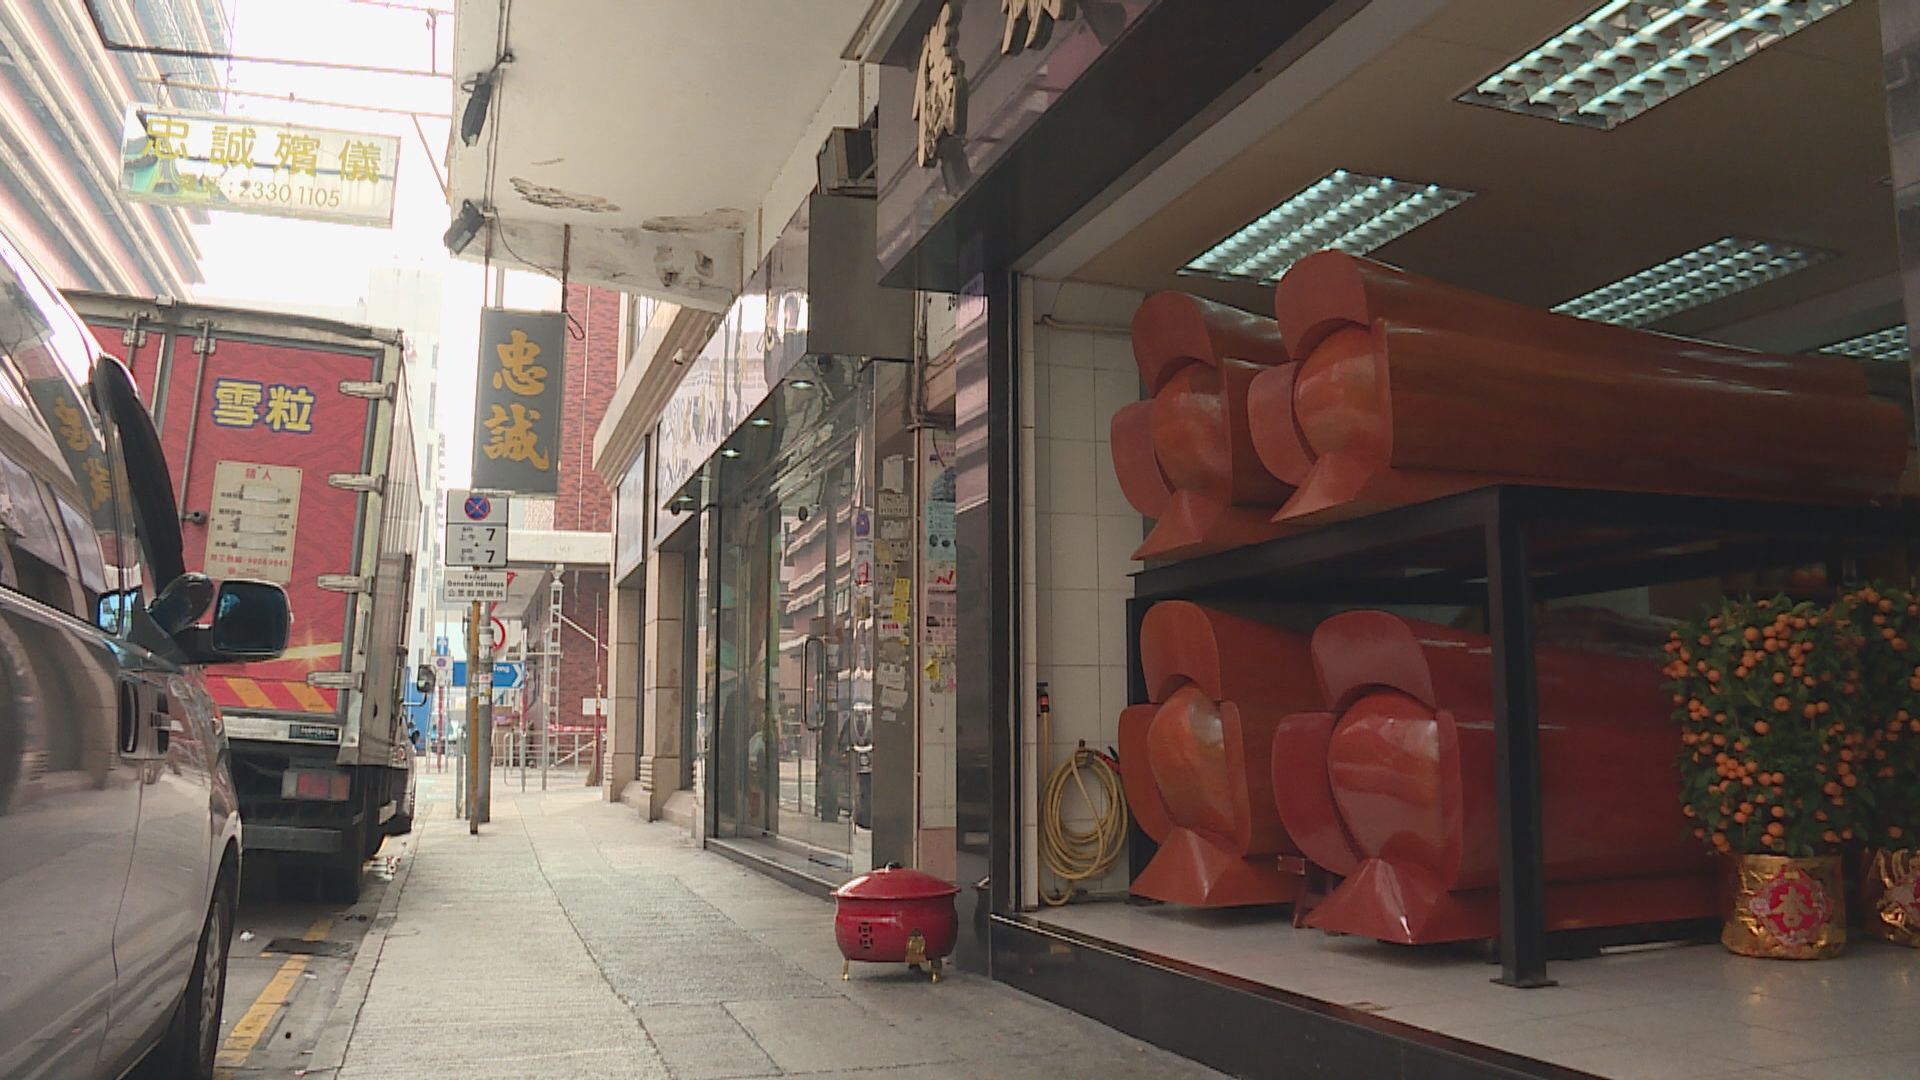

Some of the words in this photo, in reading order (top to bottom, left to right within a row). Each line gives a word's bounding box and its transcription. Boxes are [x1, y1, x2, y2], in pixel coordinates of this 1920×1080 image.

[143, 115, 383, 183] 忠誠殯儀
[298, 186, 341, 208] 1105
[213, 379, 316, 434] 雪粒
[482, 328, 551, 472] 忠誠
[485, 528, 496, 542] 7
[485, 550, 496, 564] 7
[447, 580, 474, 588] General
[475, 581, 504, 589] Holidays
[464, 573, 487, 581] Except
